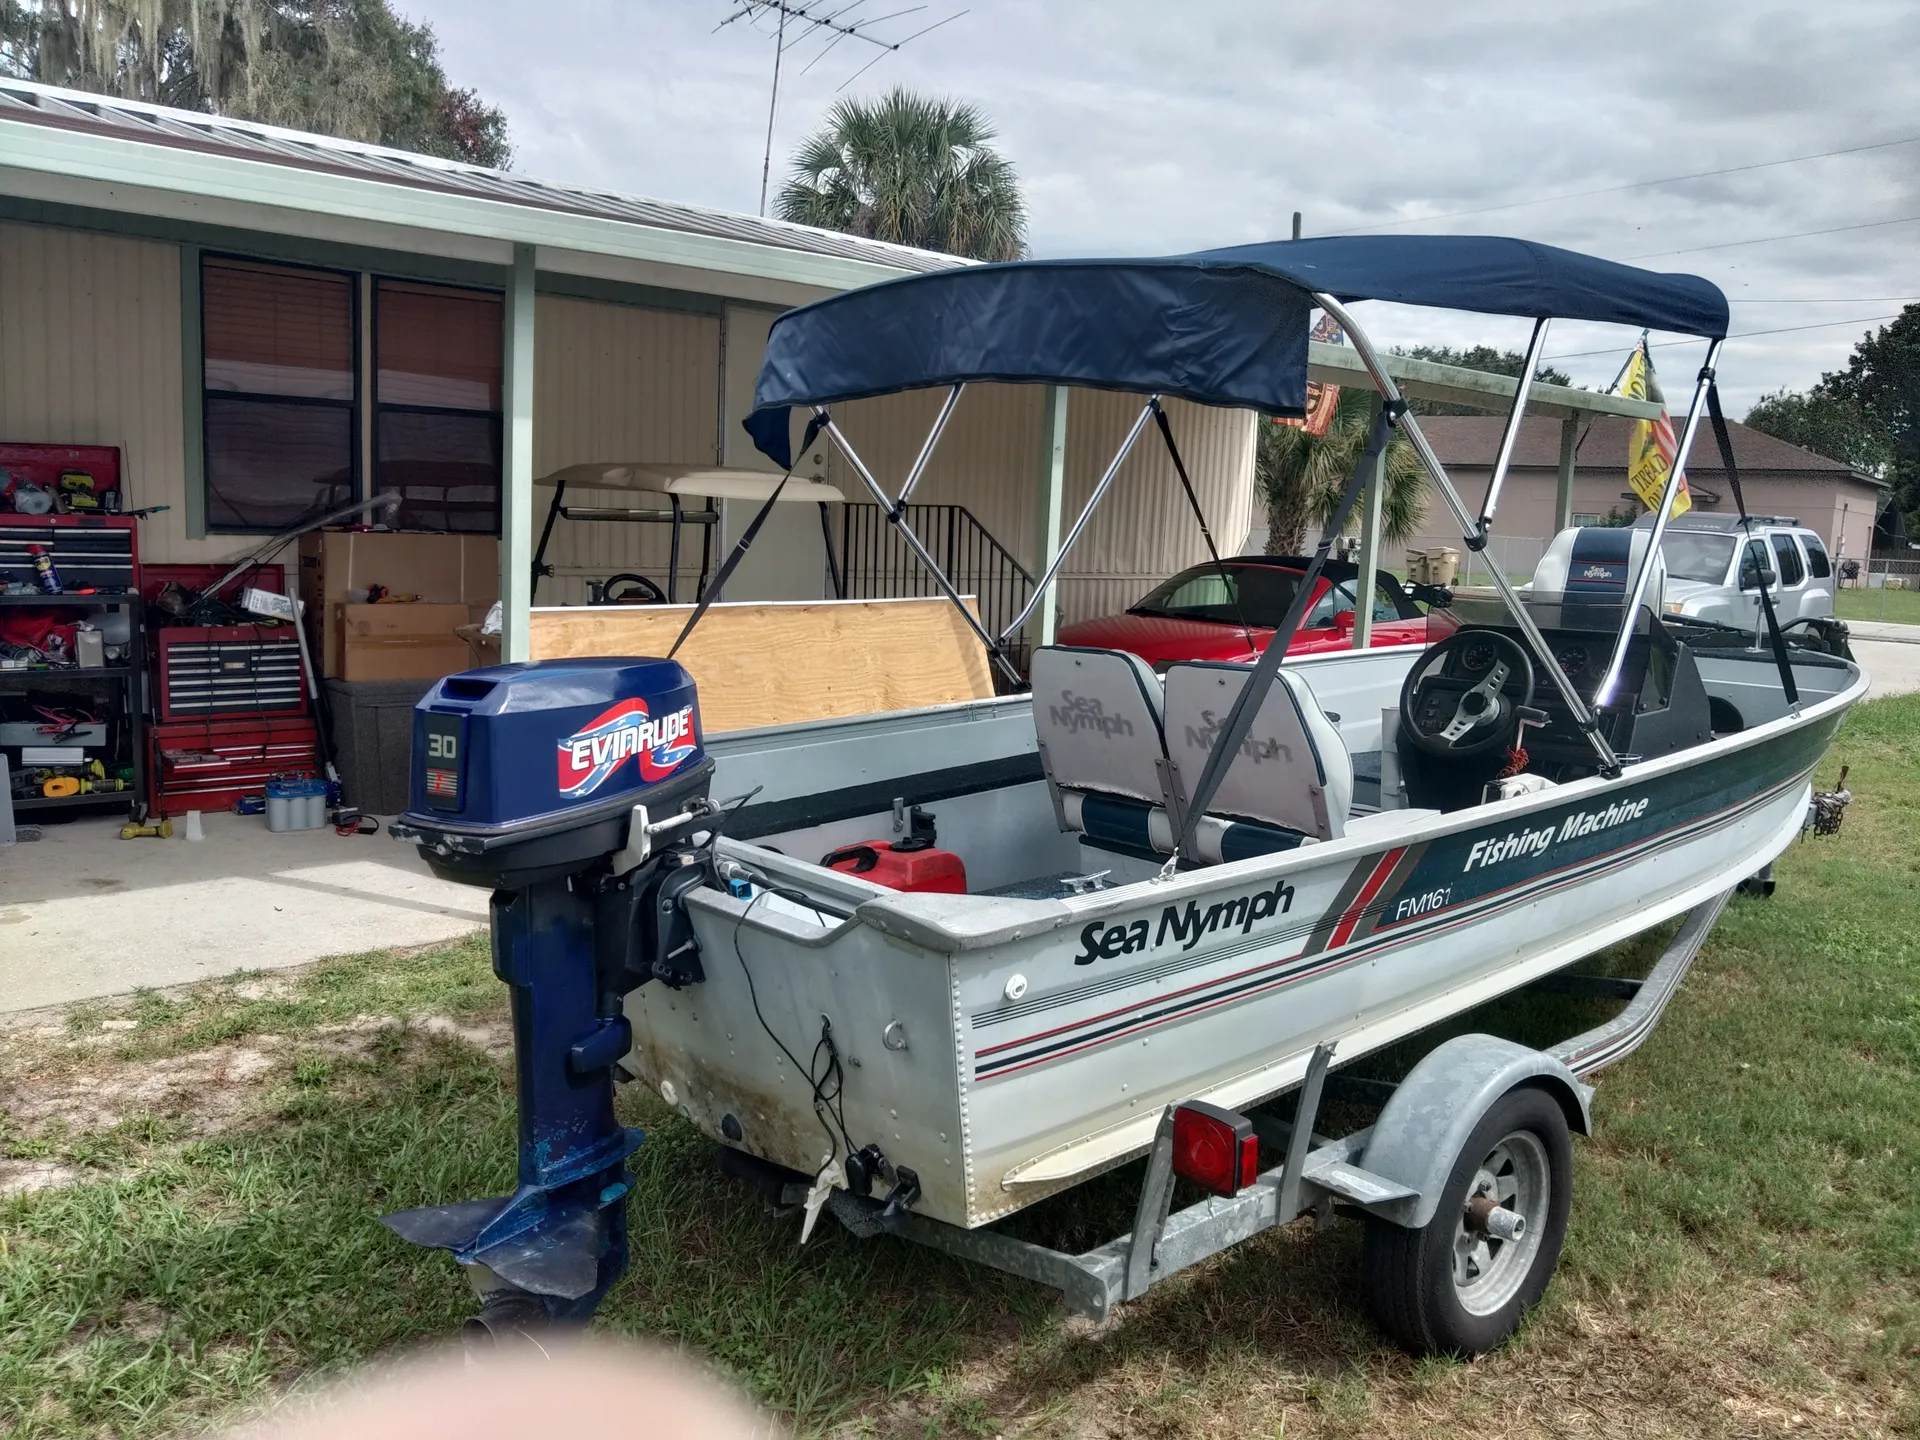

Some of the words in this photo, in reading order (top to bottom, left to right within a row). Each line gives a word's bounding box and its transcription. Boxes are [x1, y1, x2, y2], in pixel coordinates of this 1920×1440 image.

[1631, 454, 1669, 493] TREAD
[1584, 570, 1612, 578] Nymph
[1061, 690, 1103, 715] Sea
[571, 709, 690, 771] EVINRUDE
[1049, 704, 1135, 739] Nymph
[428, 734, 456, 759] 30
[1463, 825, 1555, 872] Fishing
[1556, 797, 1649, 843] Machine
[1074, 919, 1150, 966] Sea
[1155, 880, 1295, 951] Nymph
